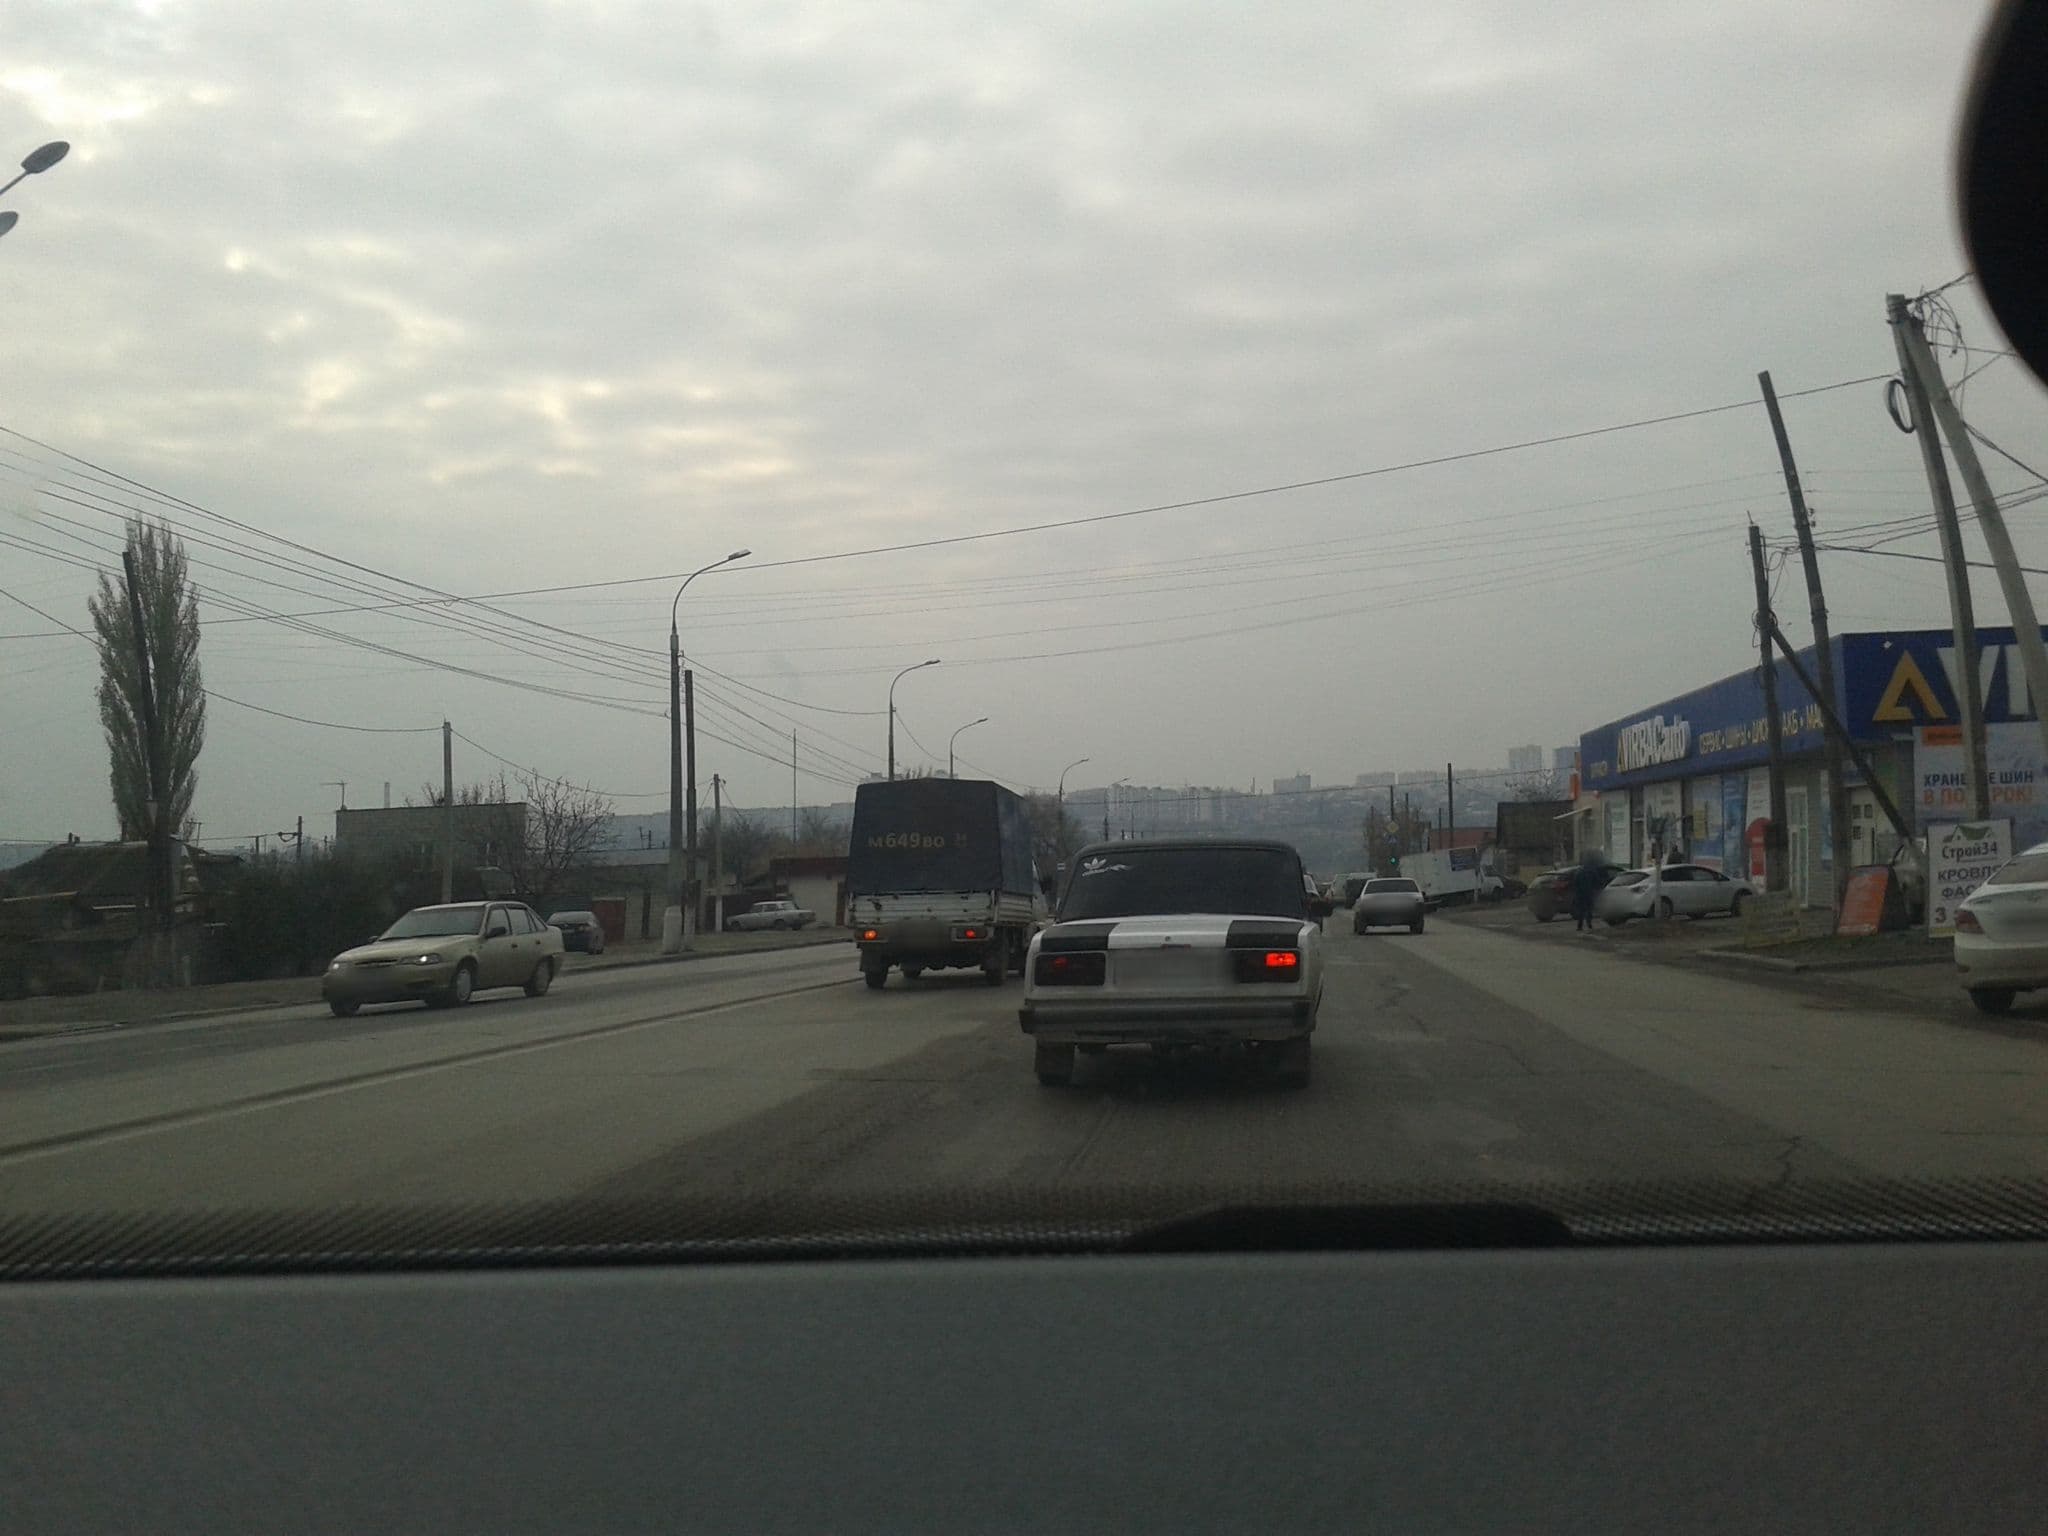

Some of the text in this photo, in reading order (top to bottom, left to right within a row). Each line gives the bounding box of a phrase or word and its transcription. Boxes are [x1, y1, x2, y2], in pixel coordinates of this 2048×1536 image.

[1999, 770, 2034, 784] ШИН
[1923, 789, 1935, 805] В
[1942, 842, 1998, 864] Строй34
